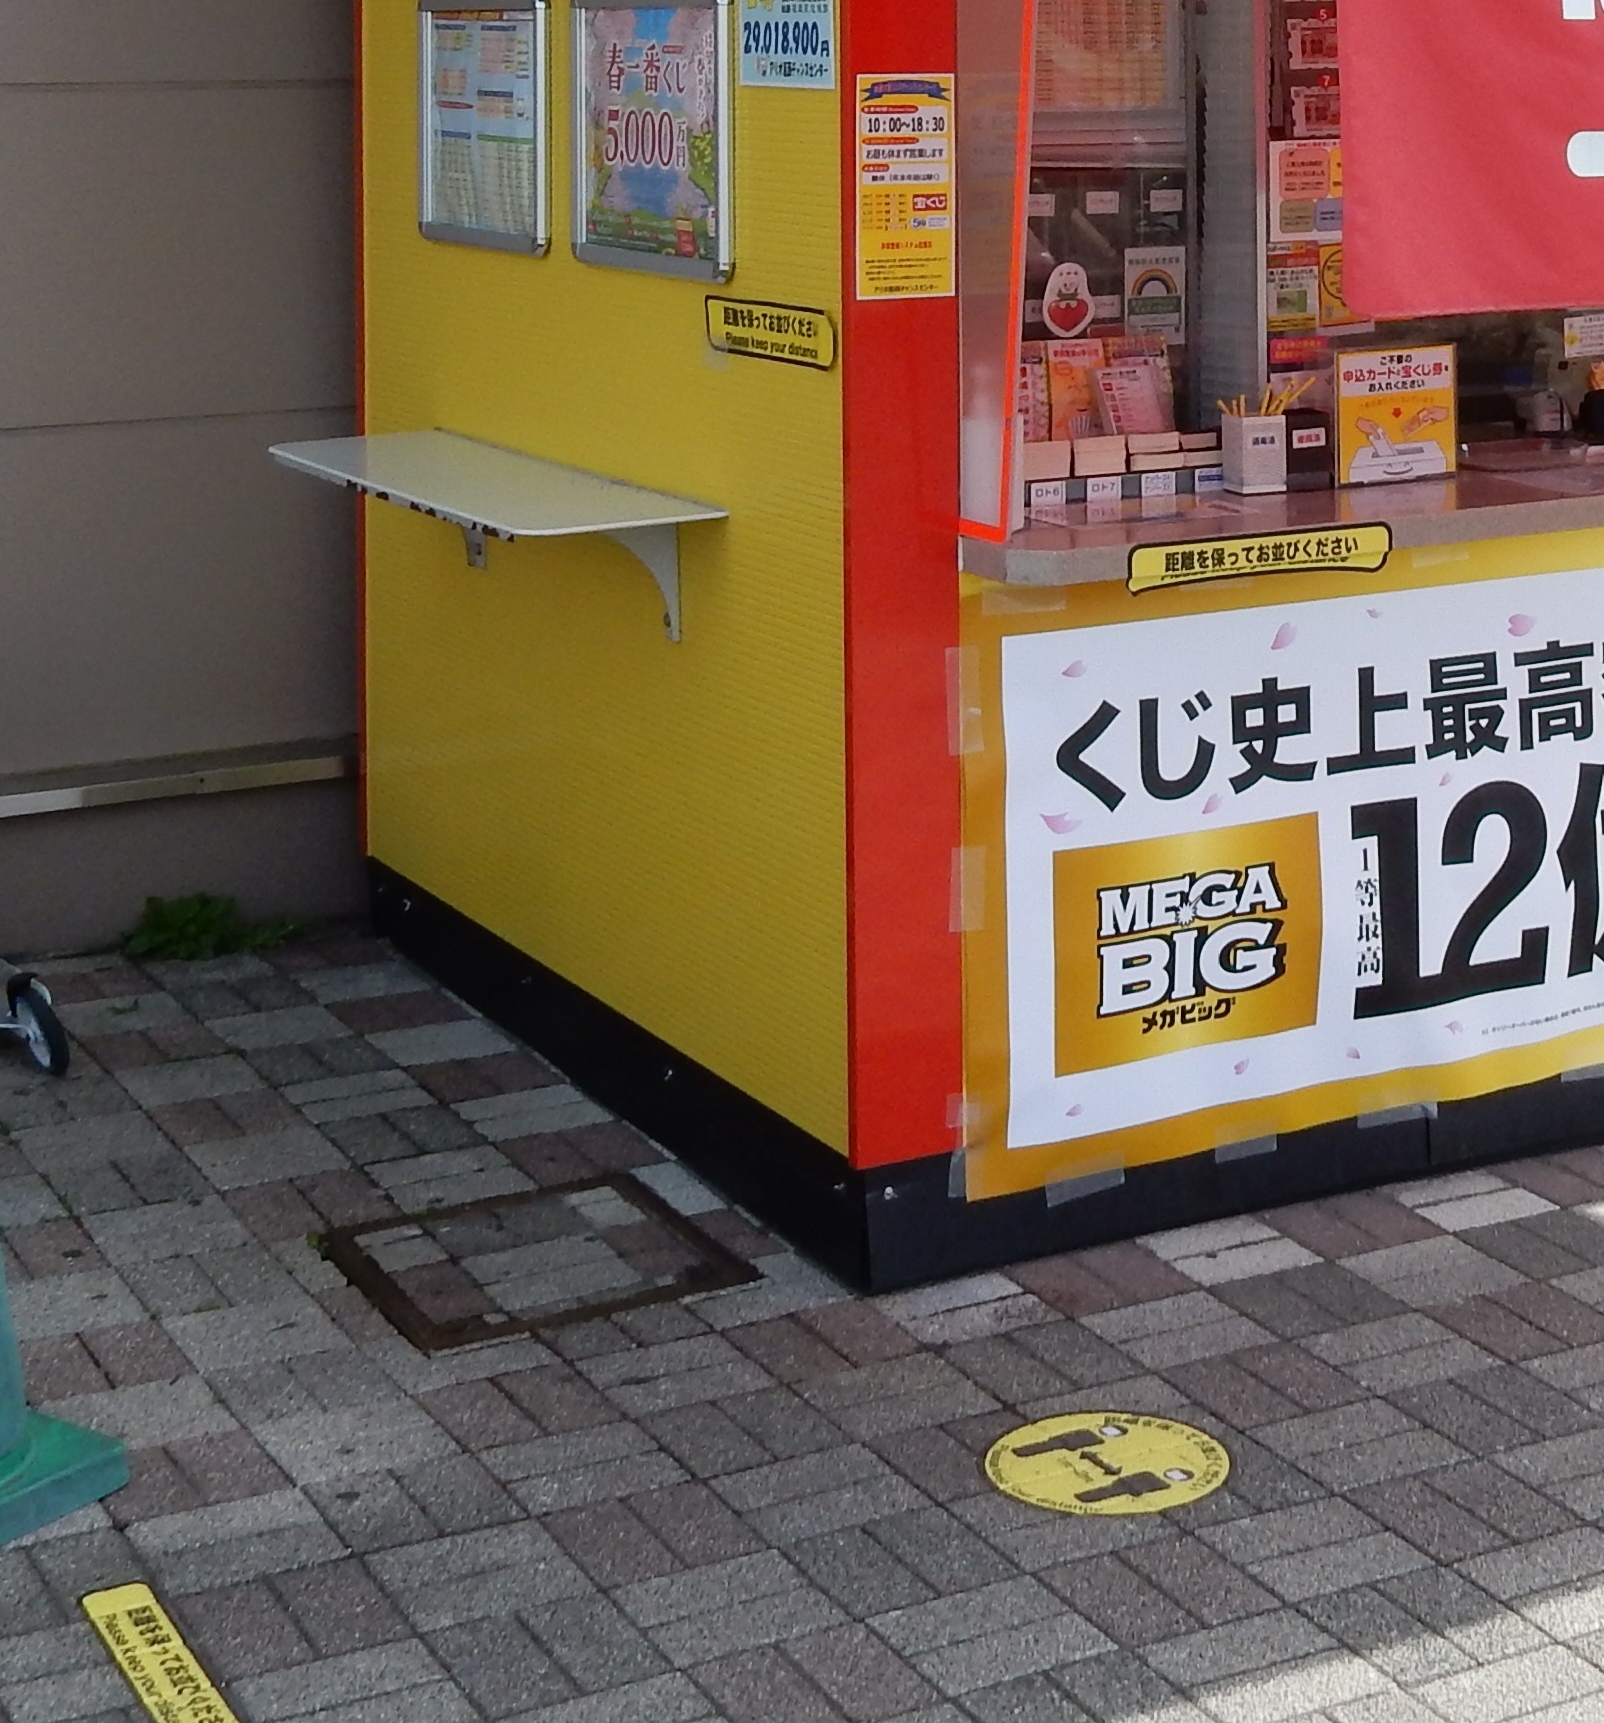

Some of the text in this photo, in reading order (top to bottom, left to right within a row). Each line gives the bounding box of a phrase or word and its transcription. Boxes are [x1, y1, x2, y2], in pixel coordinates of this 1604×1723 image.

[606, 42, 687, 94] 春一番くじ
[1035, 485, 1060, 498] ロト6
[1091, 481, 1117, 494] ロト7
[1164, 536, 1360, 574] 距離を保ってお並びください
[1098, 861, 1288, 940] MEGA
[1097, 917, 1287, 1020] BIG
[1141, 995, 1237, 1034] メガビッグ
